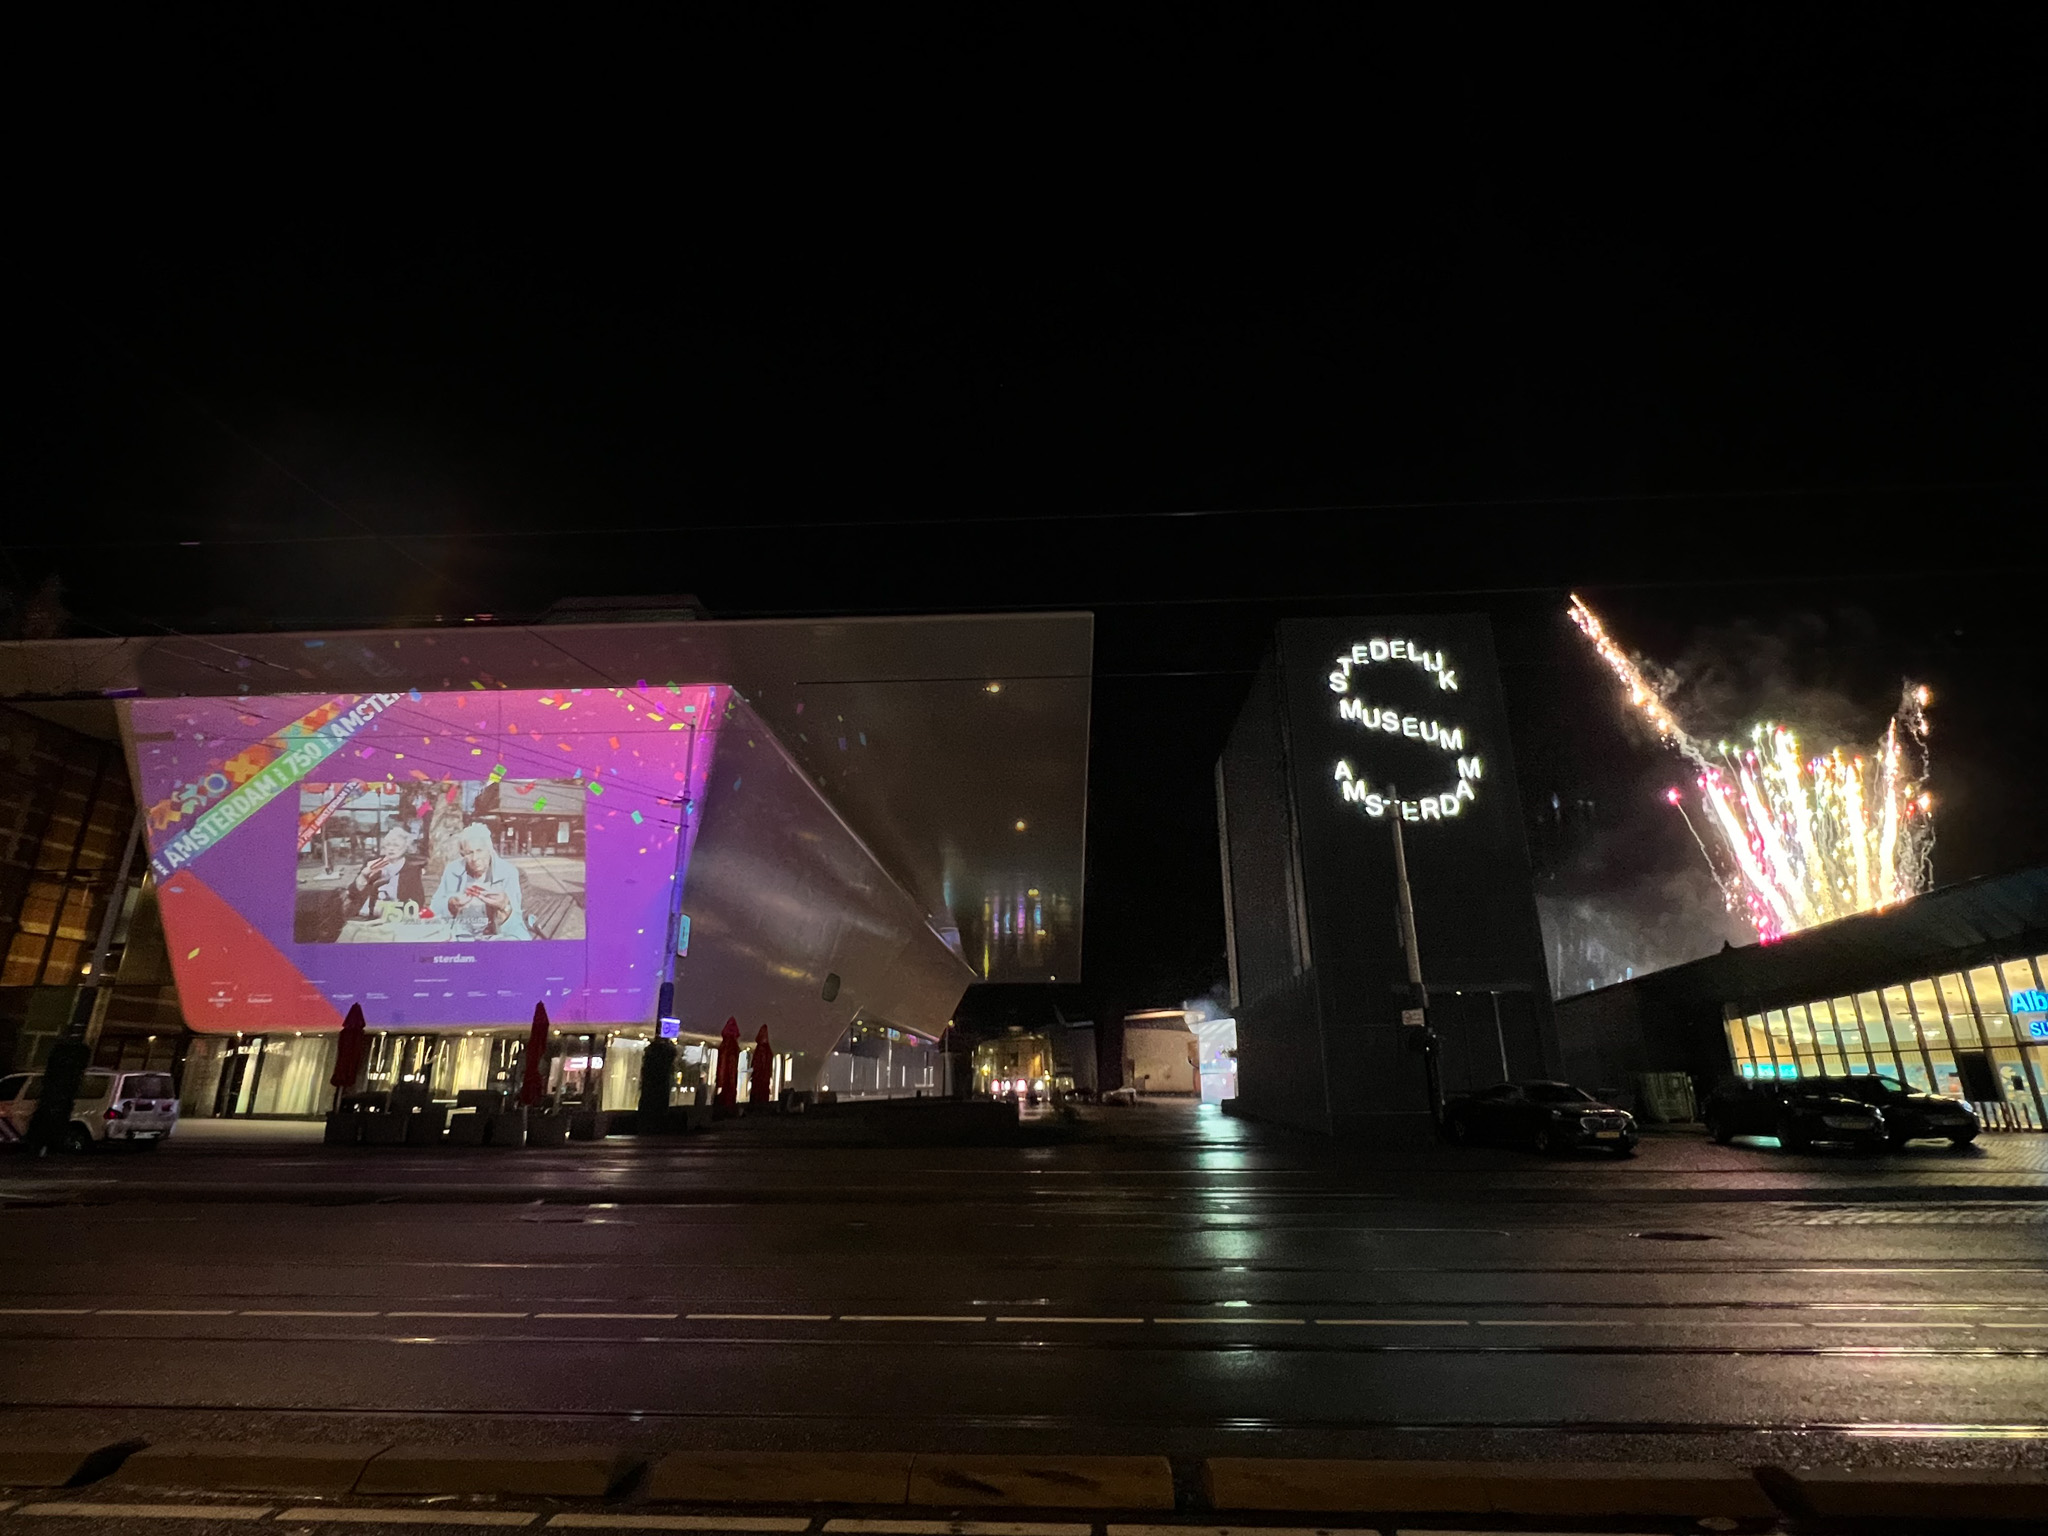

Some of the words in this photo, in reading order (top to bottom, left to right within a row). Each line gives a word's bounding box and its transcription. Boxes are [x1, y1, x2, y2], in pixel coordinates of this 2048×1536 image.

[1329, 640, 1458, 692] STEDELIJK
[1339, 698, 1463, 750] MUSEUM
[163, 773, 277, 868] AMSTERDAM
[282, 742, 322, 776] 750
